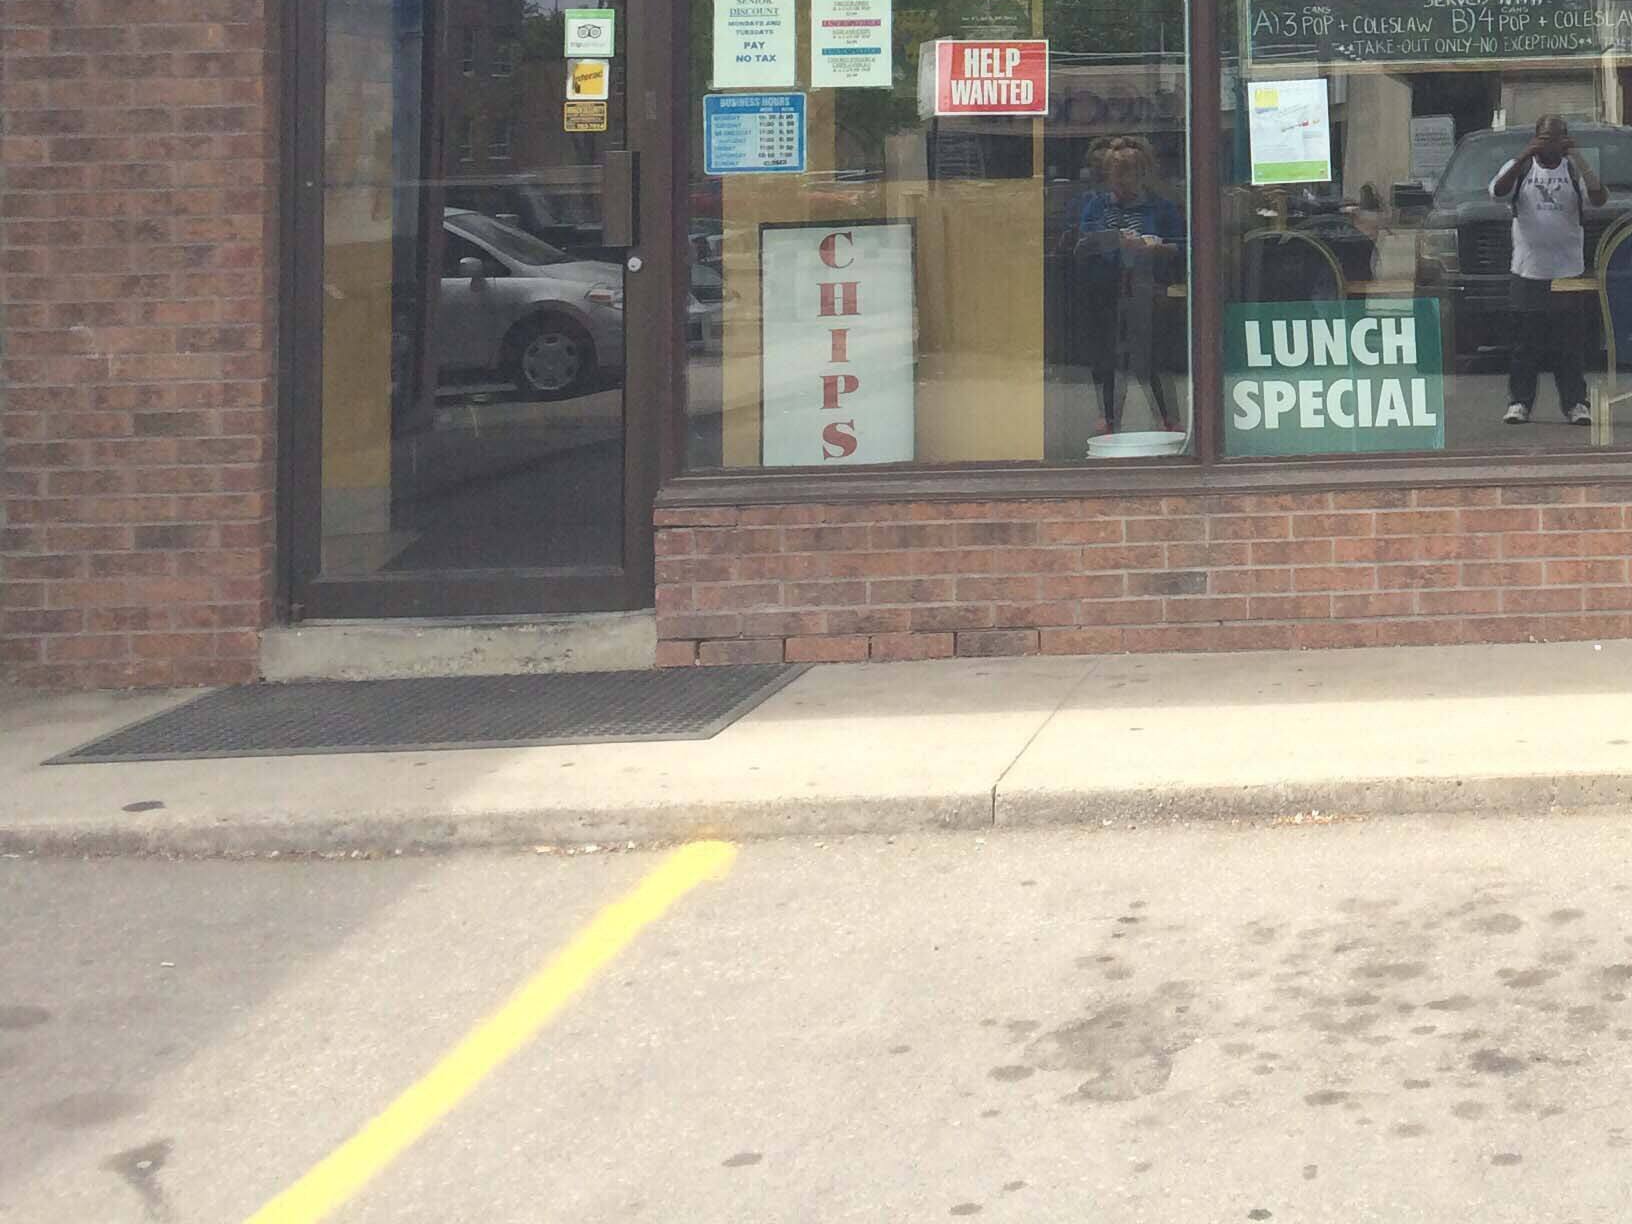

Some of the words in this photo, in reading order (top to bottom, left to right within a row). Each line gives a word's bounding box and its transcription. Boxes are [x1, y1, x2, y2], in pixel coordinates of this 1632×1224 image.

[729, 7, 780, 16] DISCOUNT
[1283, 11, 1298, 37] 3
[1302, 15, 1334, 36] POP
[1352, 15, 1432, 35] COLESLAW
[1478, 7, 1494, 34] 4
[1499, 14, 1531, 32] POP
[736, 55, 752, 63] NO
[755, 54, 777, 63] TAX
[743, 41, 766, 50] PAY
[964, 48, 1021, 78] HELP
[951, 79, 1034, 105] WANTED
[816, 231, 861, 461] CHIPS
[1244, 317, 1417, 367] LUNCH
[1233, 377, 1438, 430] SPECIAL
